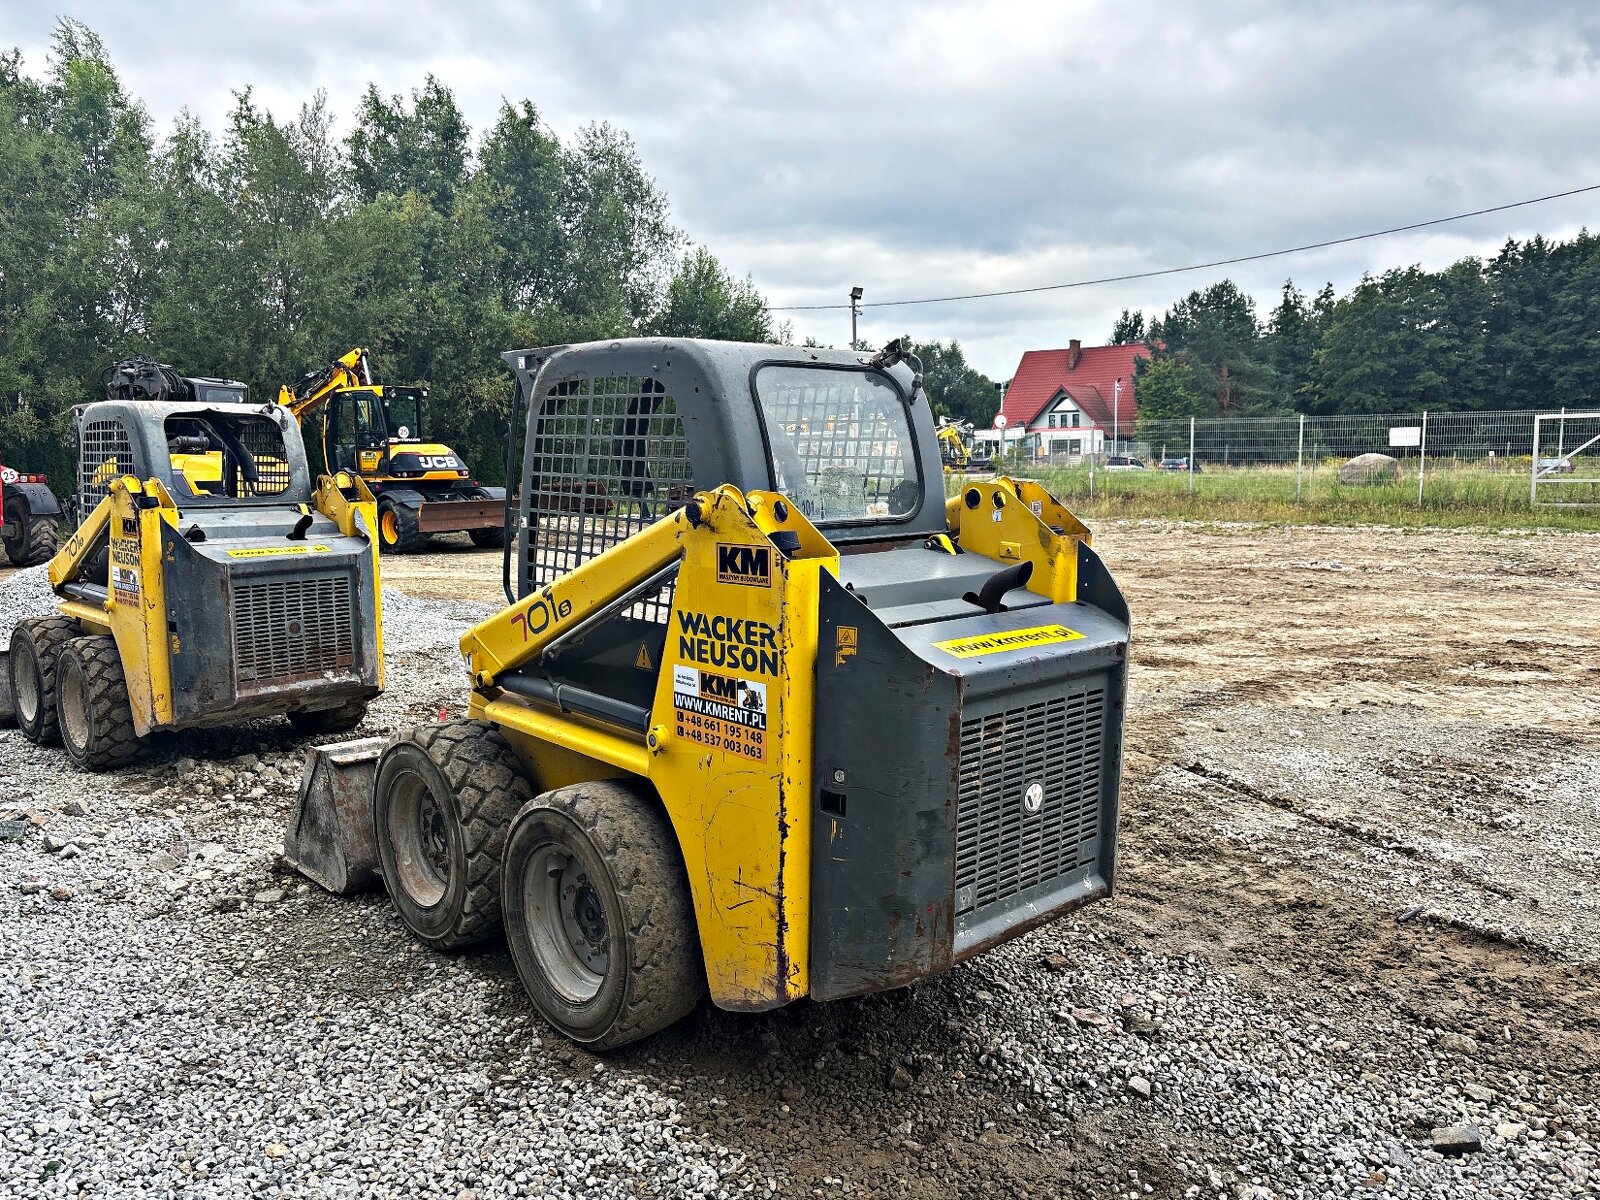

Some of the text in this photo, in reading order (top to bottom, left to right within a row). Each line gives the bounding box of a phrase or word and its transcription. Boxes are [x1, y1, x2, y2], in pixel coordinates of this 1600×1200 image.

[3, 471, 15, 480] 25
[418, 456, 458, 468] JCB
[122, 518, 137, 534] KM
[112, 550, 140, 567] NEUSON
[719, 546, 768, 577] KM
[677, 610, 778, 650] WACKER
[946, 628, 1074, 653] www.kmrent.pl
[679, 636, 779, 677] NEUSON
[701, 672, 736, 700] KM
[674, 693, 765, 729] WWW.KMRENT.PL
[685, 715, 762, 744] +48 661 195 148
[685, 729, 762, 759] +48 537 003 063
